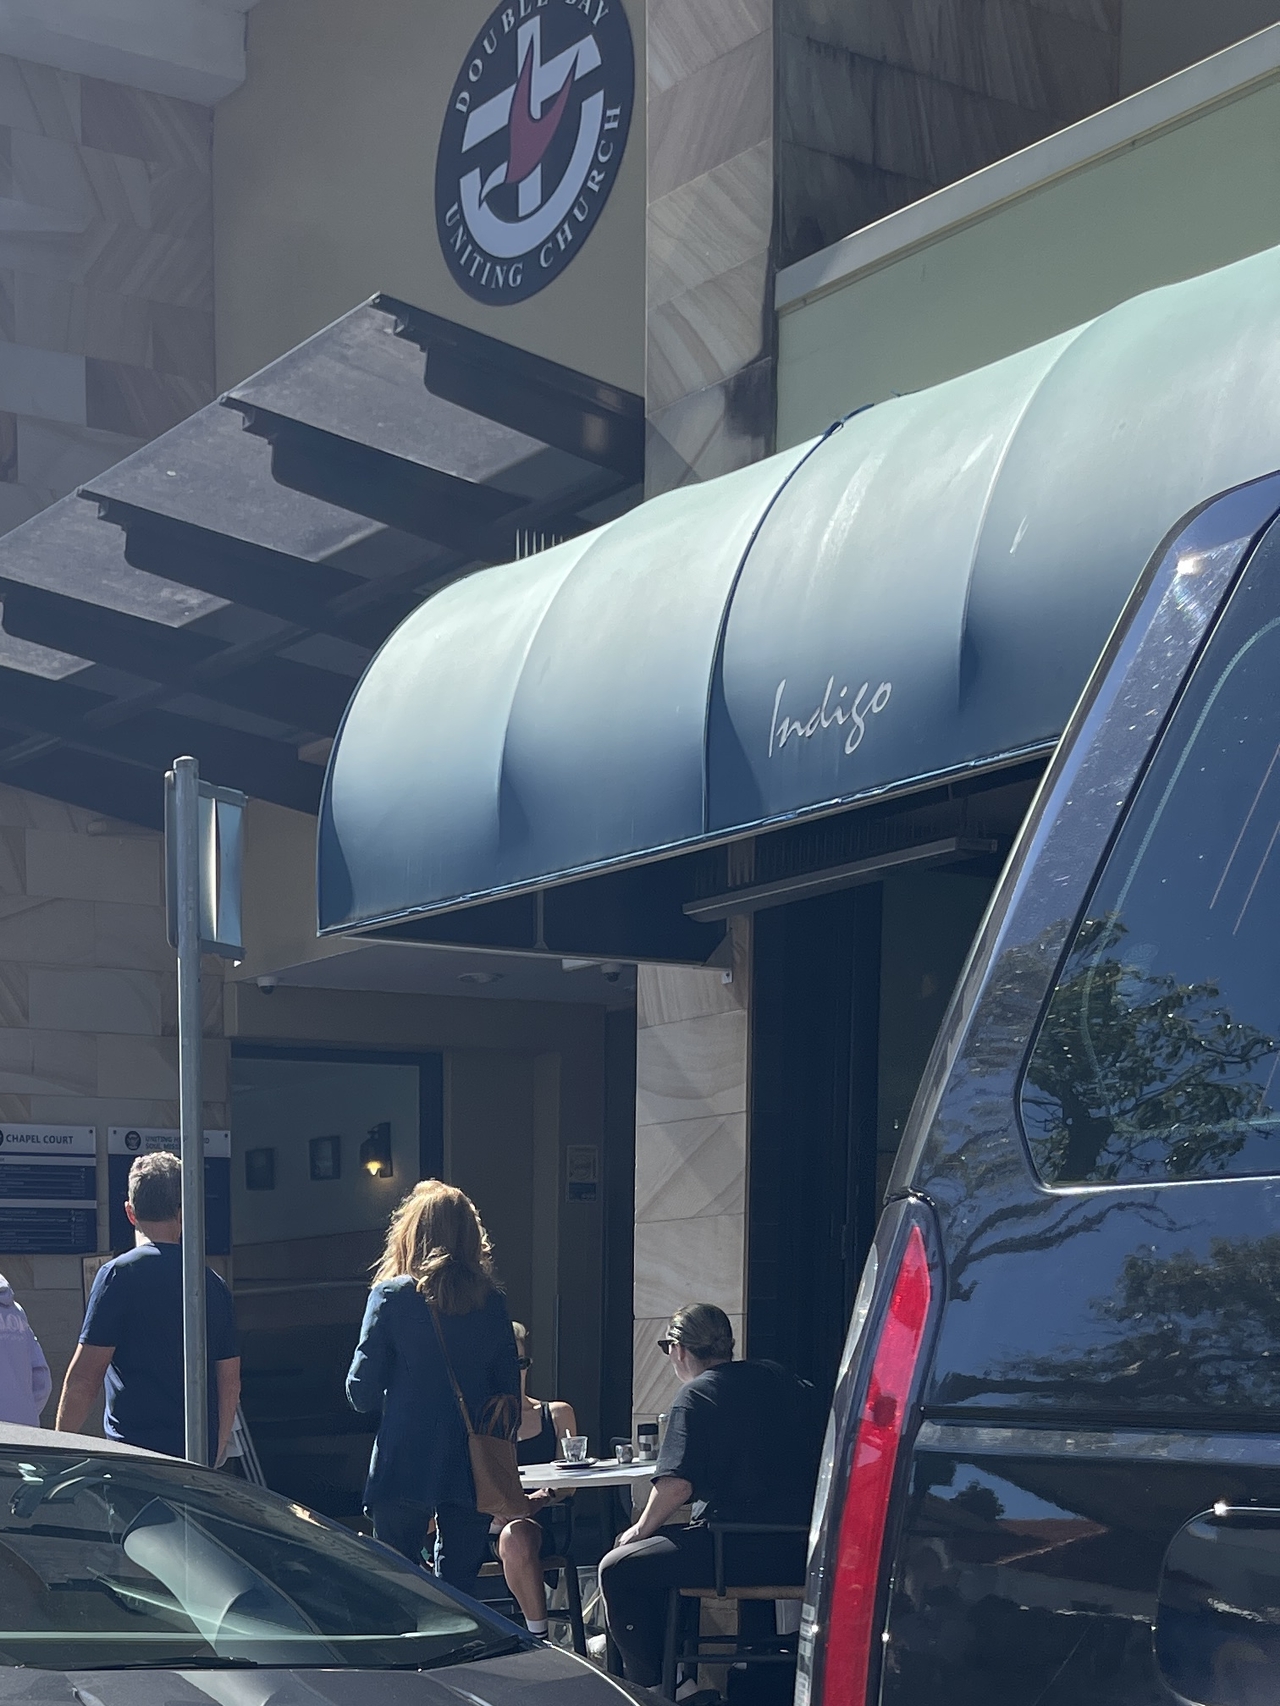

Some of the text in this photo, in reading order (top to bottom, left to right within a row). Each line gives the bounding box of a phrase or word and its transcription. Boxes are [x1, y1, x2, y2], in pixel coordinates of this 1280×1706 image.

[565, 0, 609, 26] AY
[445, 104, 622, 289] UNITING CHURCH
[768, 674, 892, 759] Indigo
[5, 1133, 74, 1145] CHAPEL COURT
